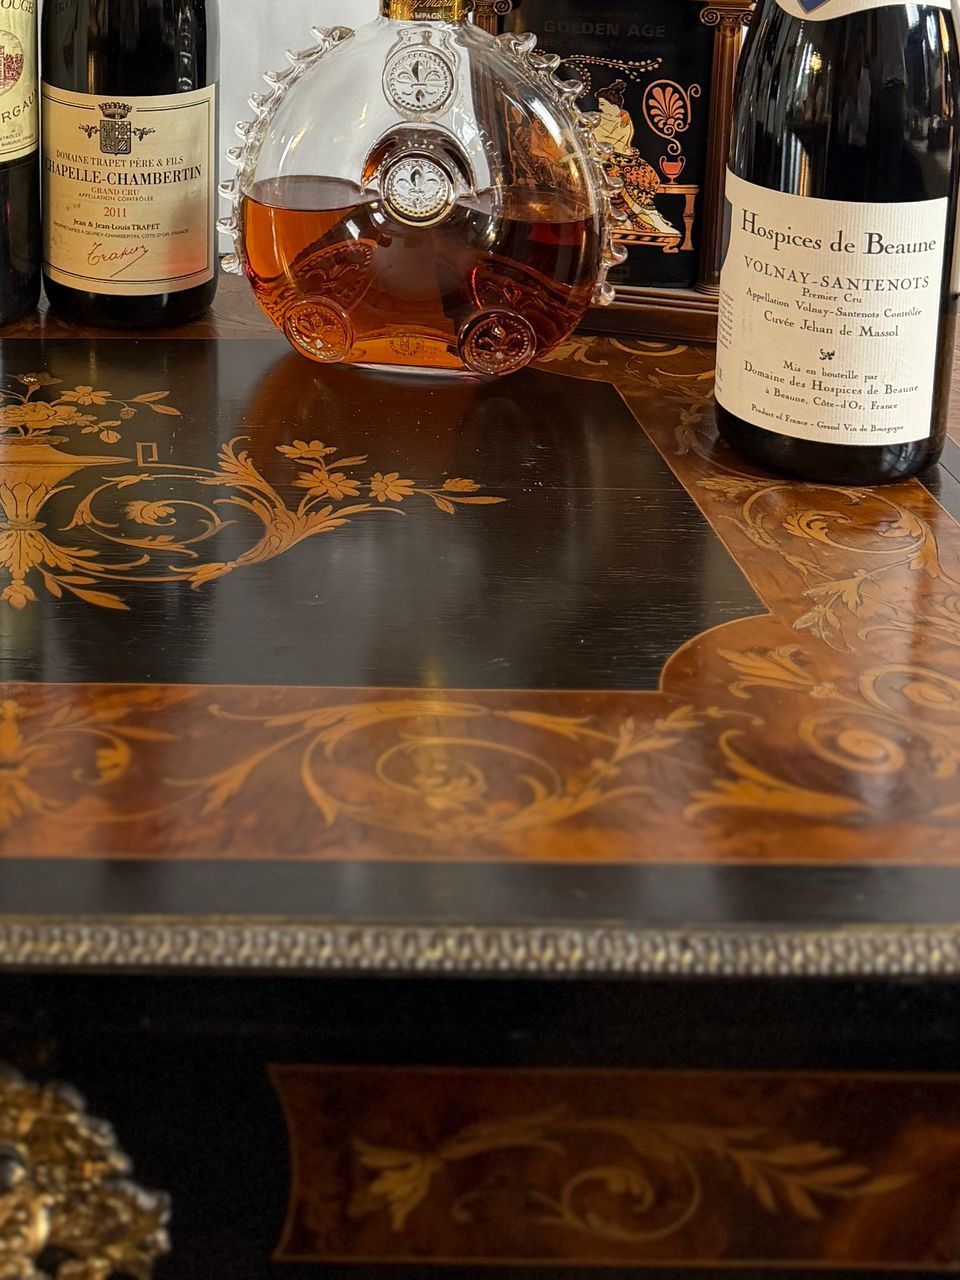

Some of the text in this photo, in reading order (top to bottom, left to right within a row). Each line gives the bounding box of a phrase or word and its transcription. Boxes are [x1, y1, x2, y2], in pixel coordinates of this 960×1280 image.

[543, 19, 666, 38] GOLDEN AGE
[56, 149, 184, 168] DOMAINE TRAPET PÈRE & FILS
[78, 193, 115, 201] APPELLATION
[91, 186, 140, 196] GRAND CRU
[103, 207, 127, 218] 2011
[73, 218, 86, 226] Jean
[94, 221, 130, 231] Jean-Louis
[131, 222, 160, 231] TRAPET
[741, 208, 937, 255] Hospices de Beaune
[743, 255, 930, 292] VOLNAY-SANTENOTS
[746, 287, 922, 319] Appellation Volnay-Santenots Contrôlée
[801, 287, 862, 304] Premier Cru
[763, 310, 899, 337] Cuvée Jehan de Massol
[744, 360, 920, 397] Domaine des Hospices de Beaune
[782, 360, 879, 384] Mis en bouteille par
[870, 400, 899, 411] France
[751, 403, 905, 435] Product of France Grand Vin de Bourgogne
